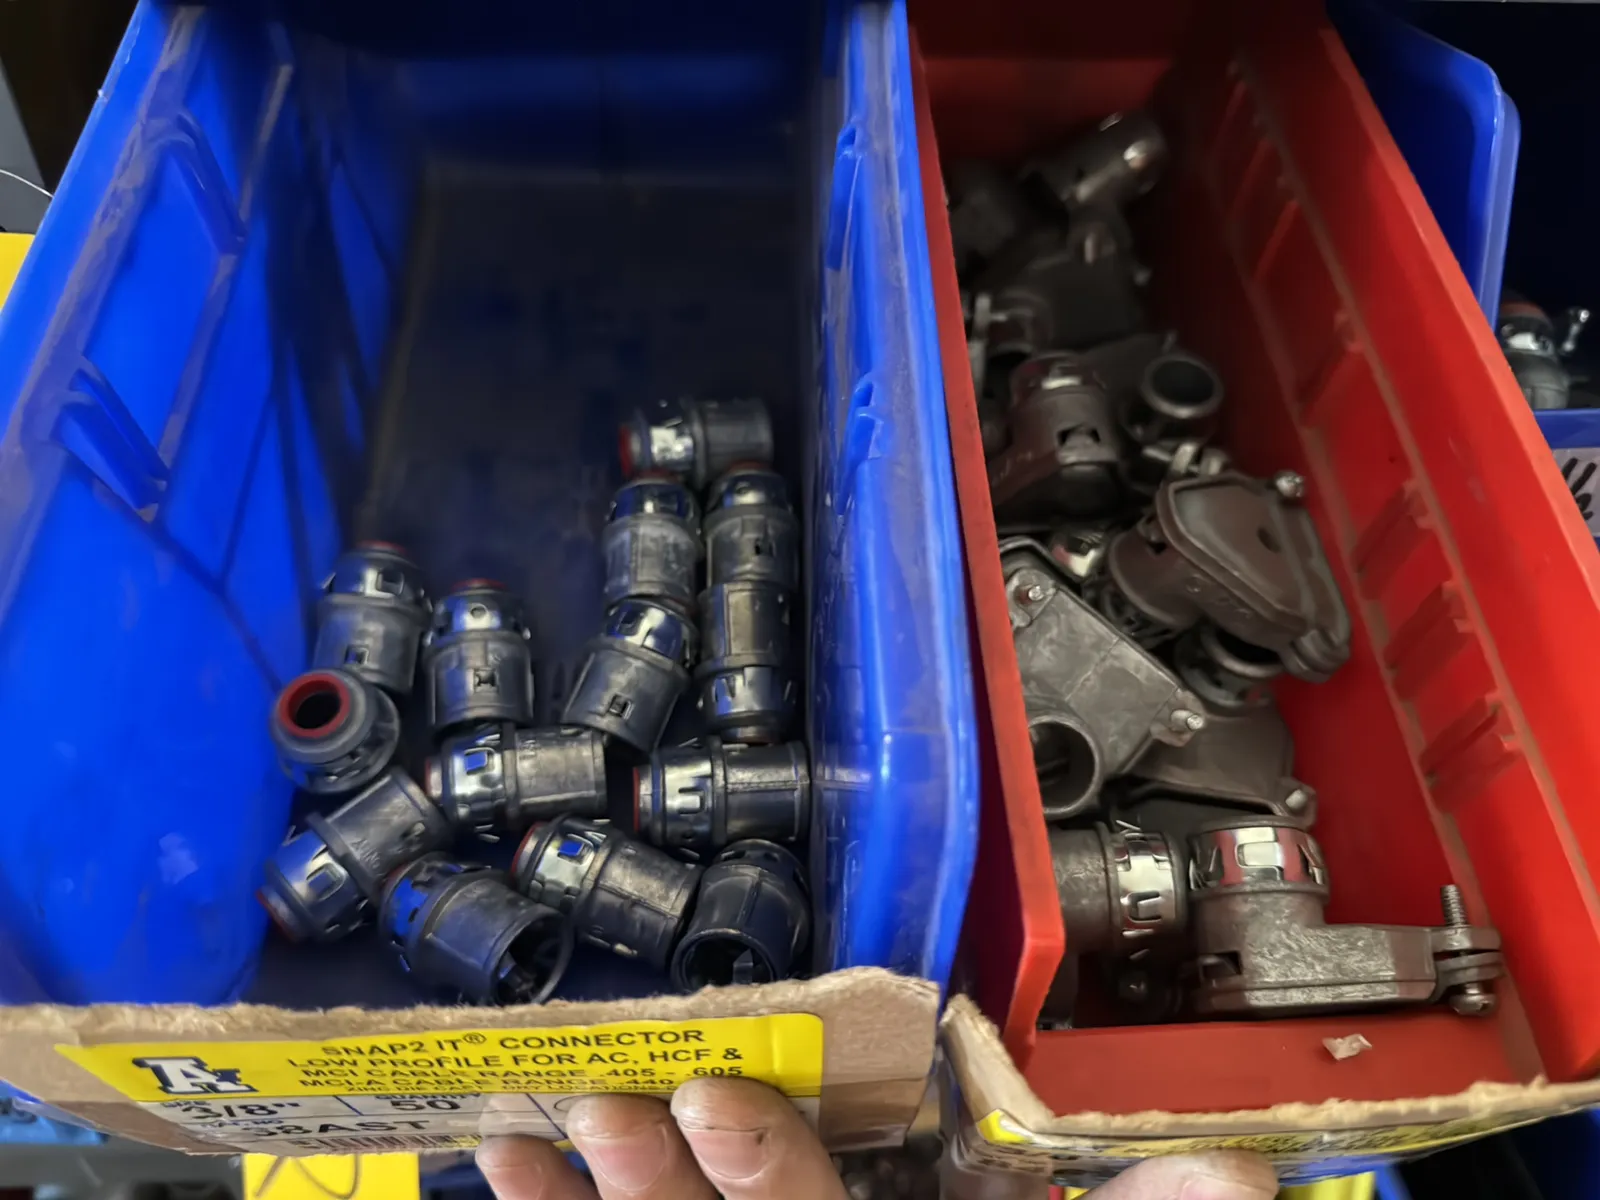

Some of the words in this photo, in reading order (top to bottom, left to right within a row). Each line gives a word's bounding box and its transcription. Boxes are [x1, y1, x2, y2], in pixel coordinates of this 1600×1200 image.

[321, 1041, 429, 1056] SNAP2
[499, 1029, 706, 1049] CONNECTOR
[287, 1058, 359, 1068] LOW
[367, 1055, 504, 1068] PROFILE
[512, 1052, 583, 1067] FOR
[587, 1051, 640, 1065] AC,
[648, 1047, 713, 1063] HCF
[722, 1047, 744, 1061] &
[300, 1069, 359, 1077] MCI
[366, 1069, 472, 1078] CABLE
[478, 1069, 588, 1078] RANGE
[600, 1067, 657, 1077] .405
[299, 1078, 386, 1087] MCI-A
[392, 1078, 493, 1086] CABLE
[501, 1077, 608, 1086] RANGE
[390, 1099, 462, 1111] 50
